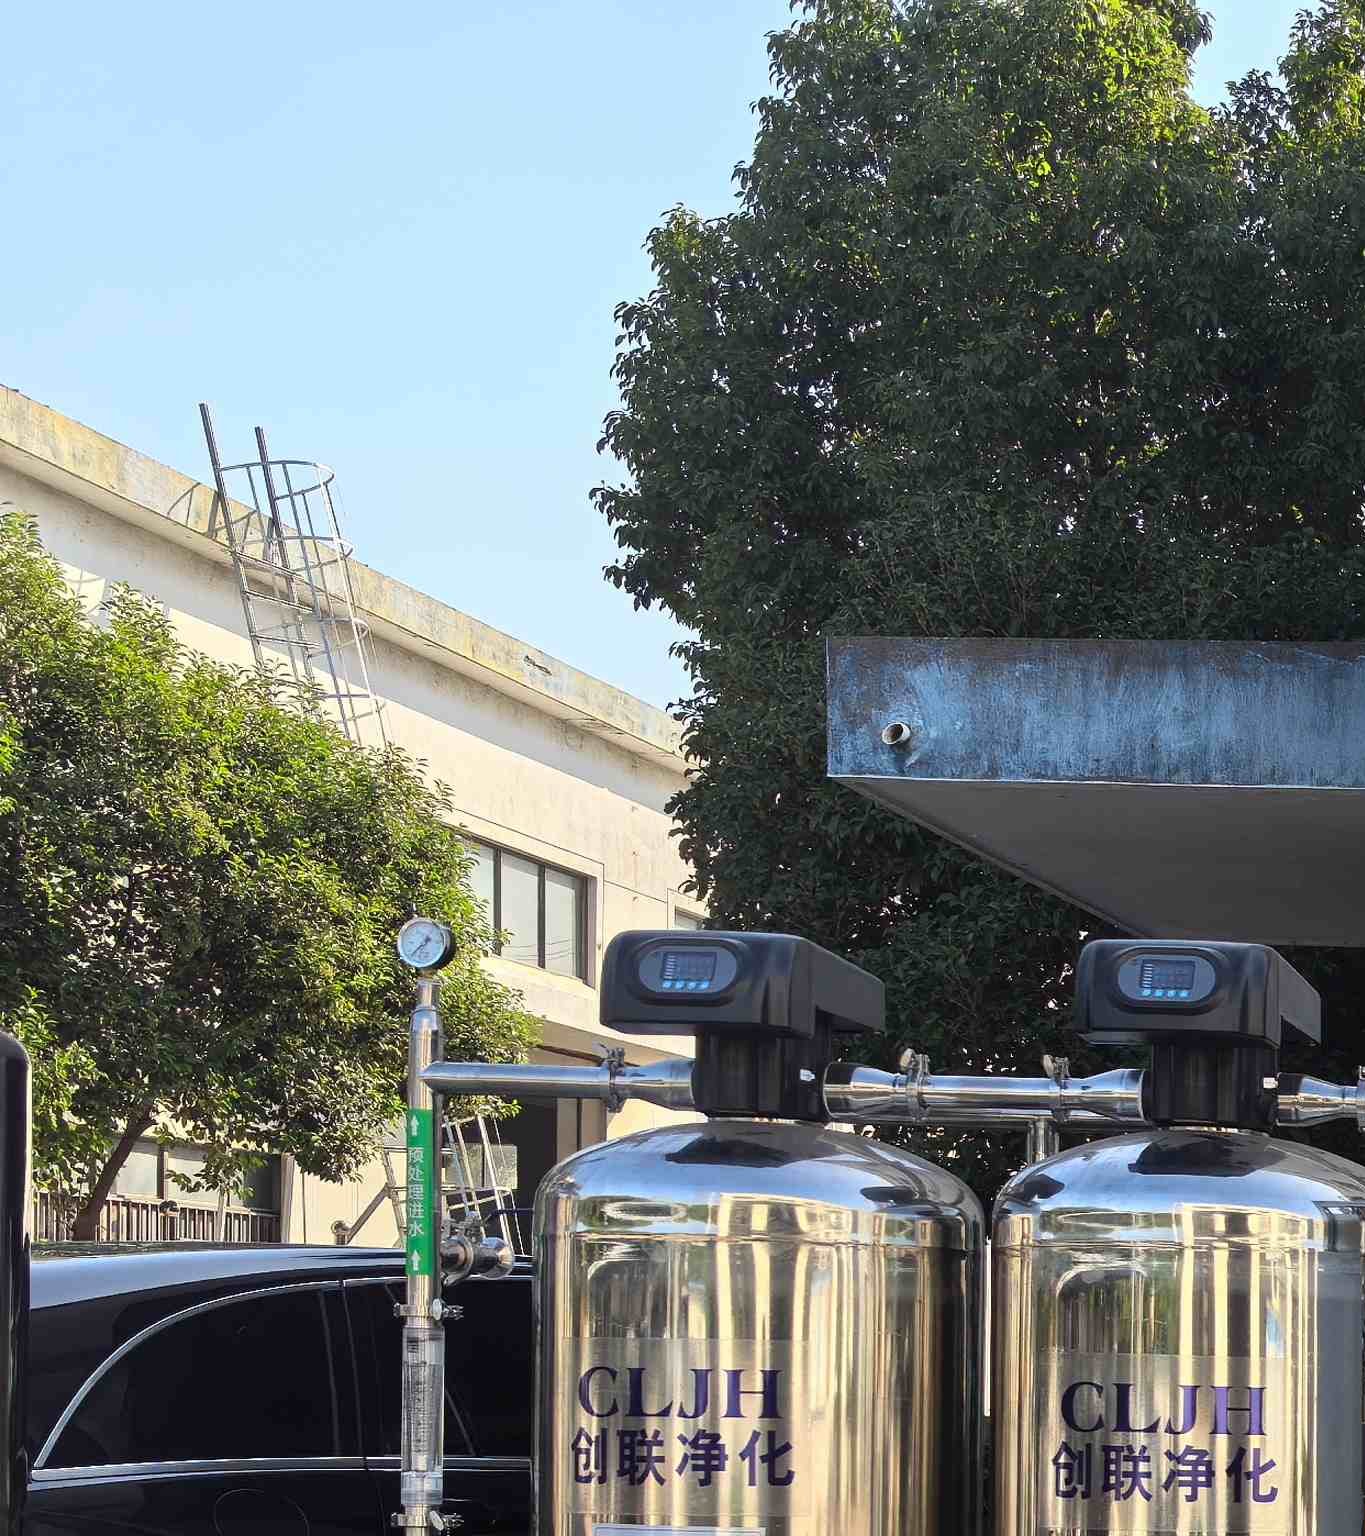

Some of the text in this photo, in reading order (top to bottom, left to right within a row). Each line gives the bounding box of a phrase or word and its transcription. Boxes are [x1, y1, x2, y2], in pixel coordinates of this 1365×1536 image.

[578, 1366, 784, 1419] CLJH
[1061, 1382, 1266, 1435] CLJH
[571, 1427, 796, 1487] 创联净化
[1052, 1441, 1278, 1503] 创联净化
